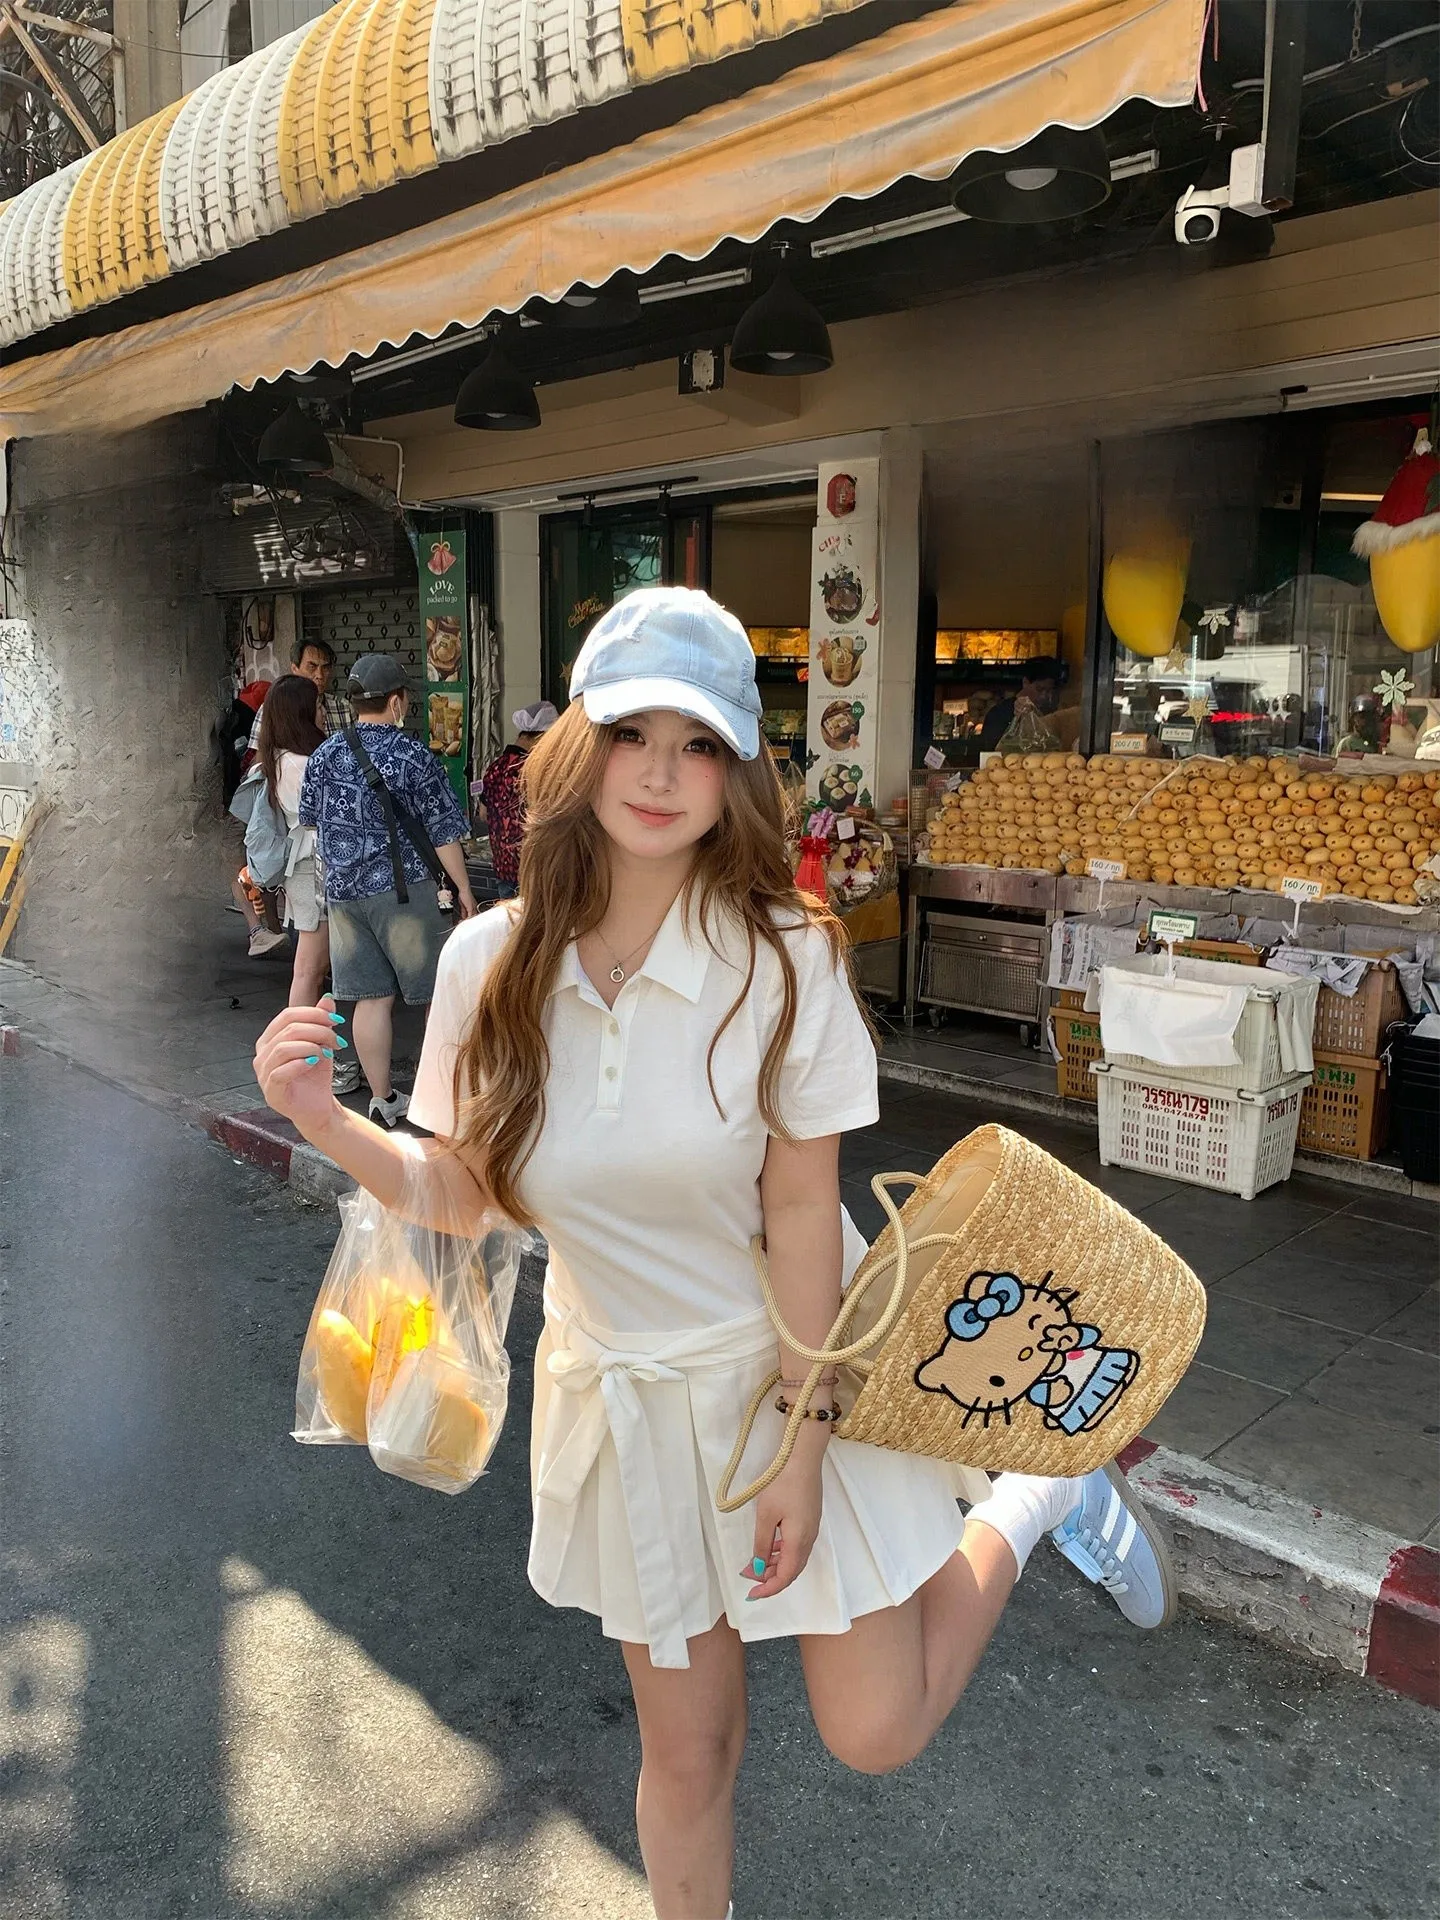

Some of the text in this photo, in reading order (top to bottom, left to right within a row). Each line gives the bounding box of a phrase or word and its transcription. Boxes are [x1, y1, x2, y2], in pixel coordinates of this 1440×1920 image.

[430, 580, 455, 595] LOVE
[1091, 861, 1103, 869] 160
[1284, 880, 1298, 889] 160
[1141, 1086, 1209, 1115] วรรณา79
